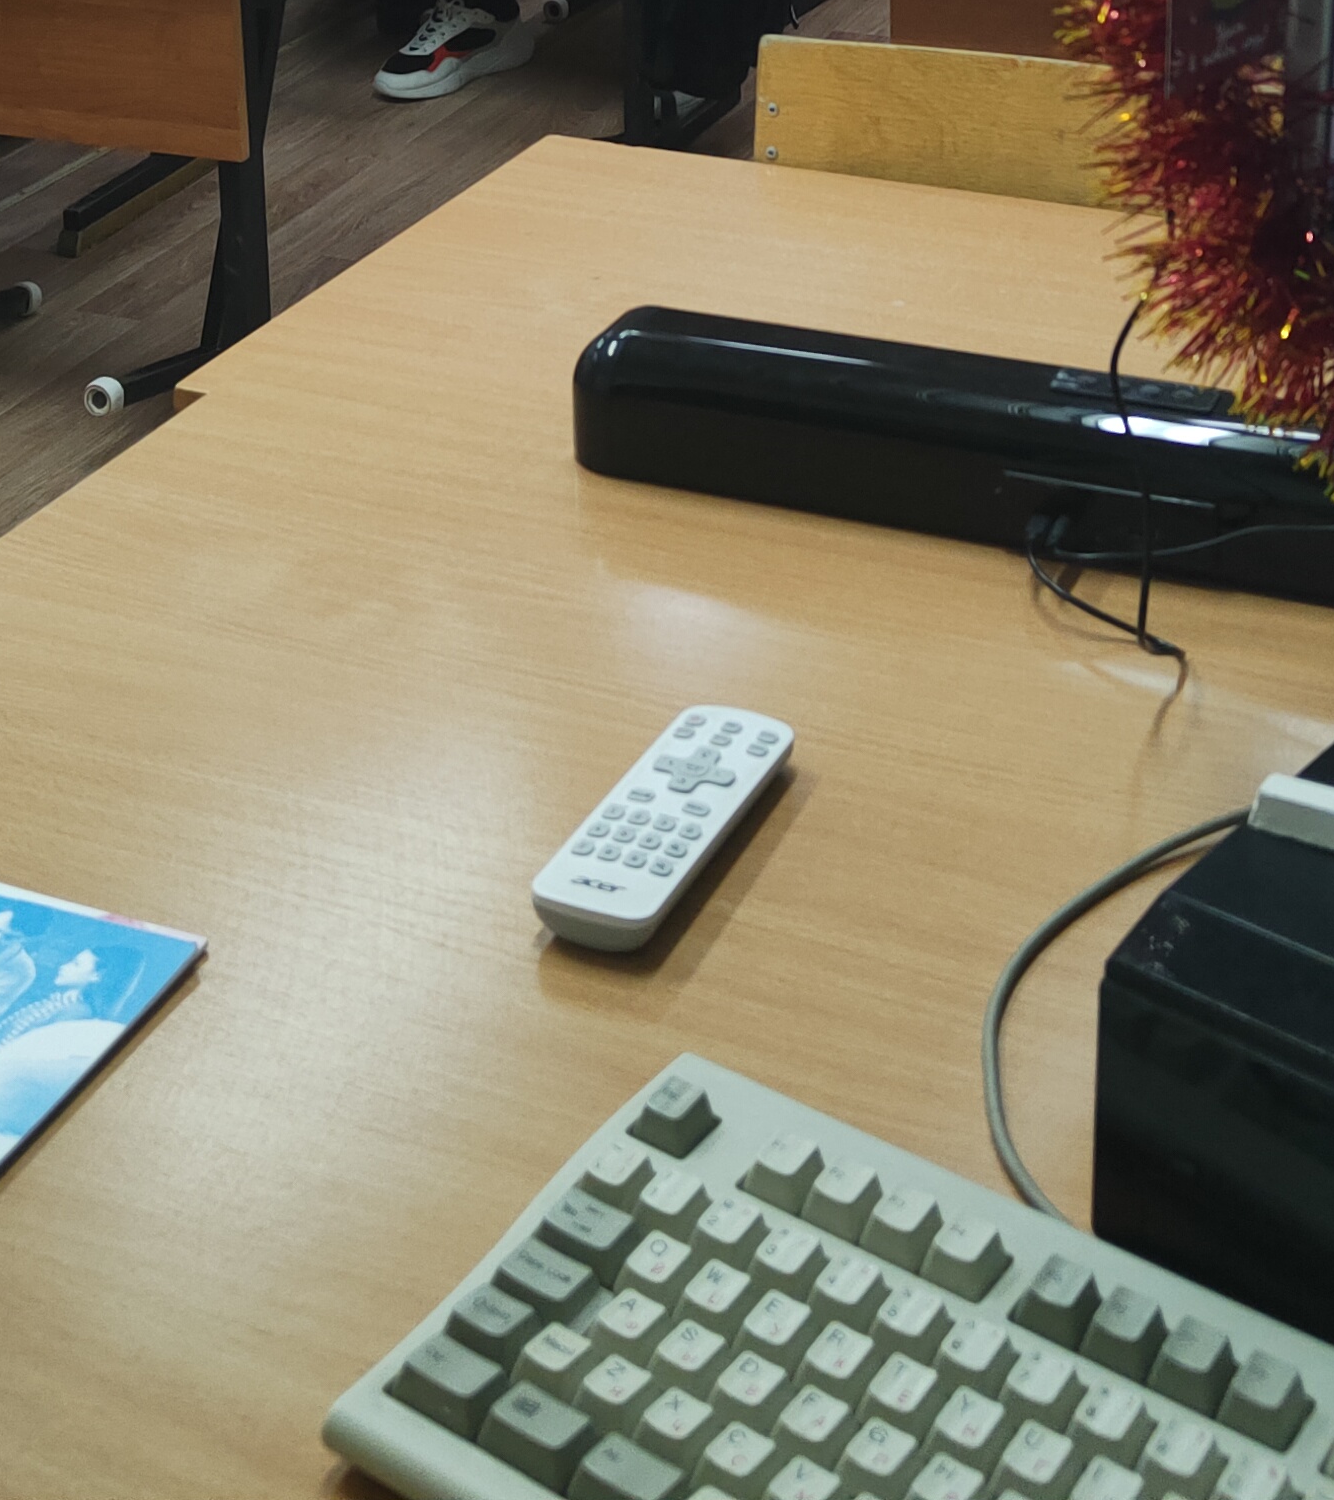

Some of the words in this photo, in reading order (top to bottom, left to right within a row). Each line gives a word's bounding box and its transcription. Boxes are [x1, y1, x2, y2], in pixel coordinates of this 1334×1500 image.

[571, 876, 627, 892] acer
[650, 1239, 668, 1257] Q
[869, 1425, 889, 1444] G
